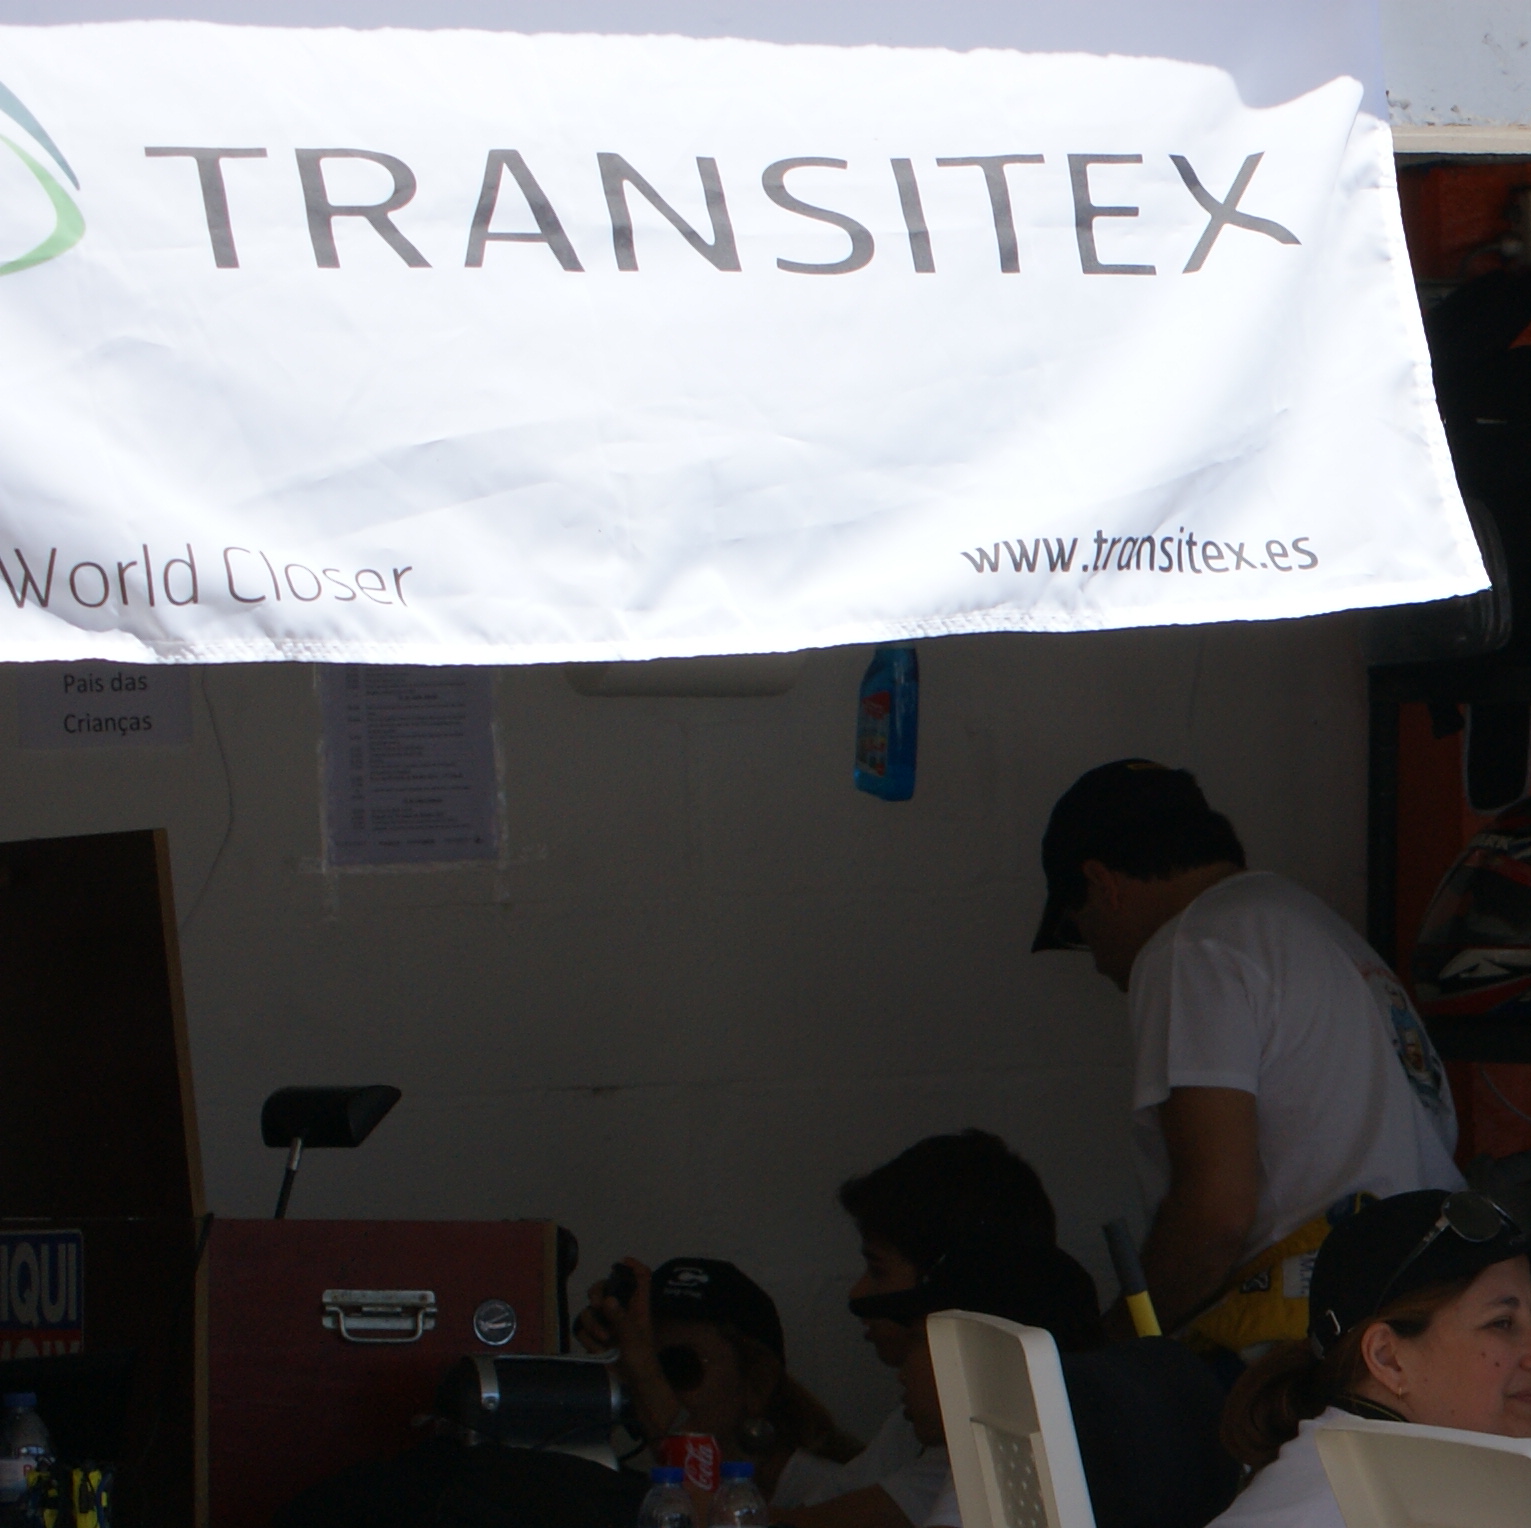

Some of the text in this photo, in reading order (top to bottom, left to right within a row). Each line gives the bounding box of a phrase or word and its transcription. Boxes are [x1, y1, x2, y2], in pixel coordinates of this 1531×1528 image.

[144, 146, 1302, 276] TRANSITEX
[0, 540, 415, 609] World Closer
[960, 525, 1320, 580] www.transitex.es
[63, 673, 148, 694] Pais das
[63, 711, 153, 738] Crianças
